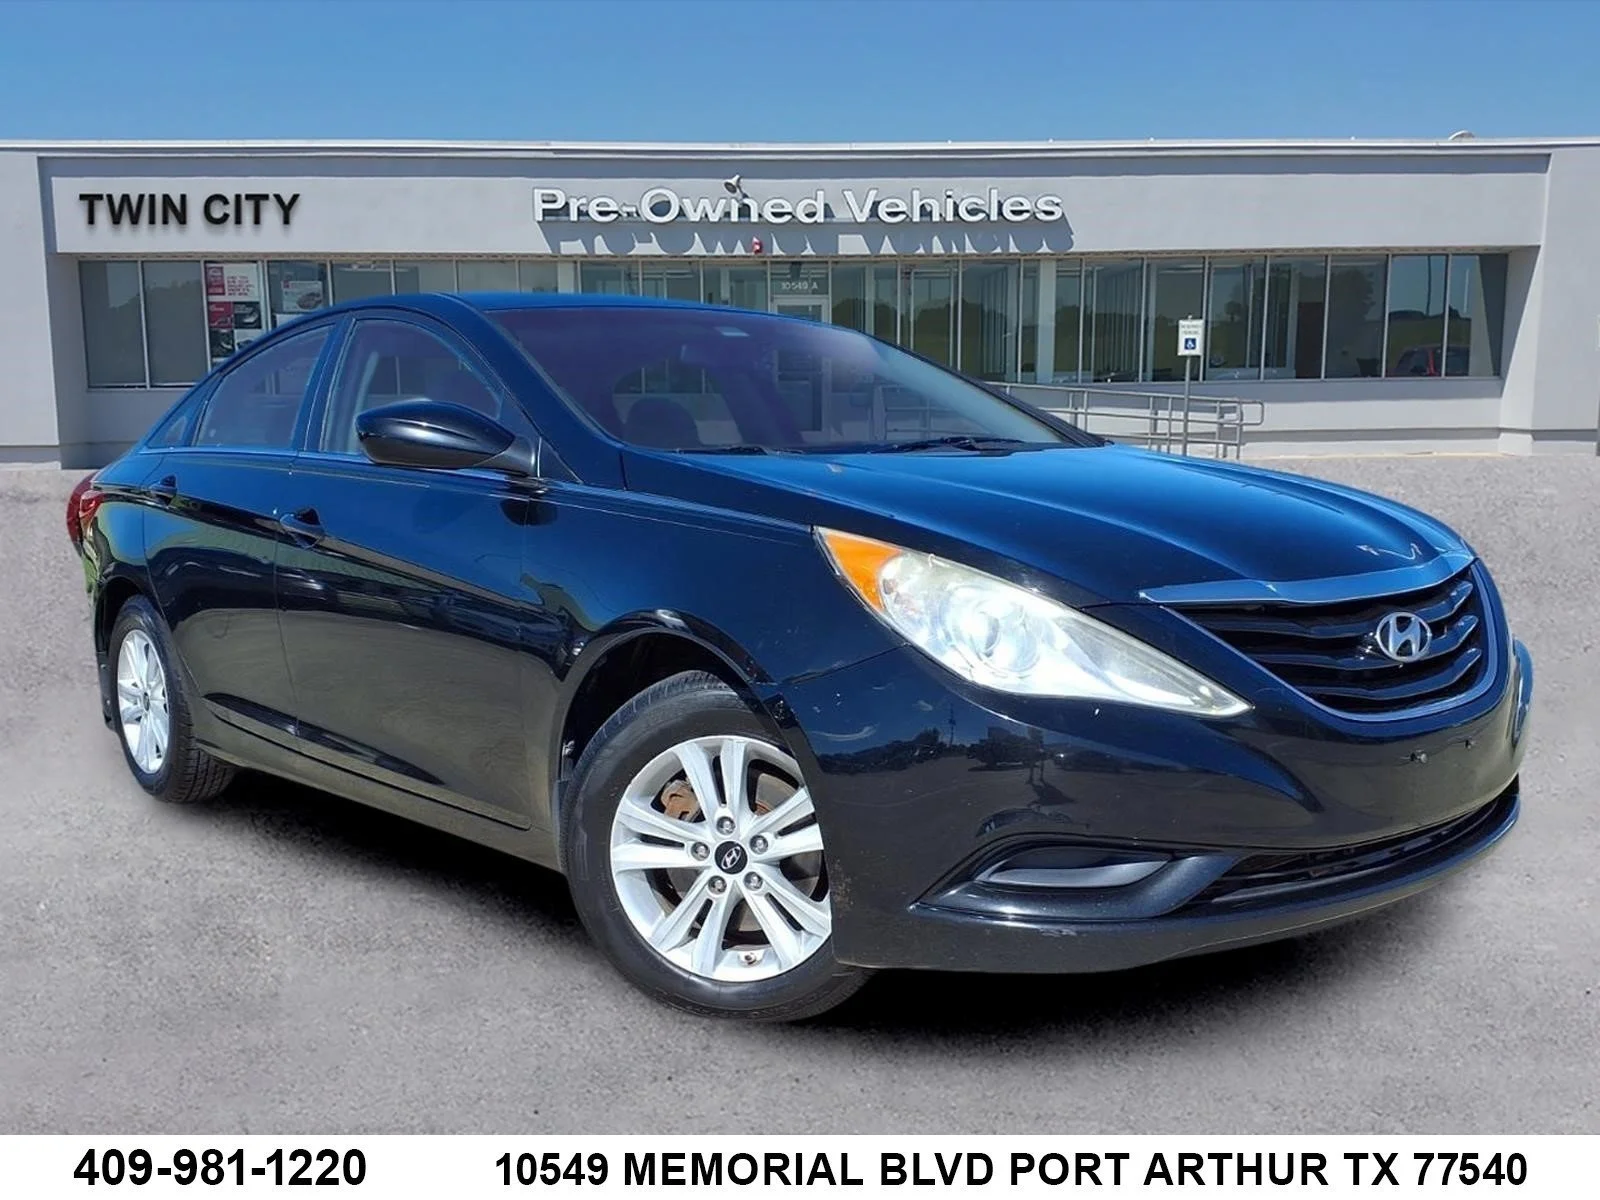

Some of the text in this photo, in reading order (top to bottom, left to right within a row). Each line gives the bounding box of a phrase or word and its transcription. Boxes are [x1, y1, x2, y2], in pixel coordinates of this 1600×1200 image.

[79, 194, 300, 225] TWIN CITY
[533, 188, 1063, 224] Pre-Owned Vehicles
